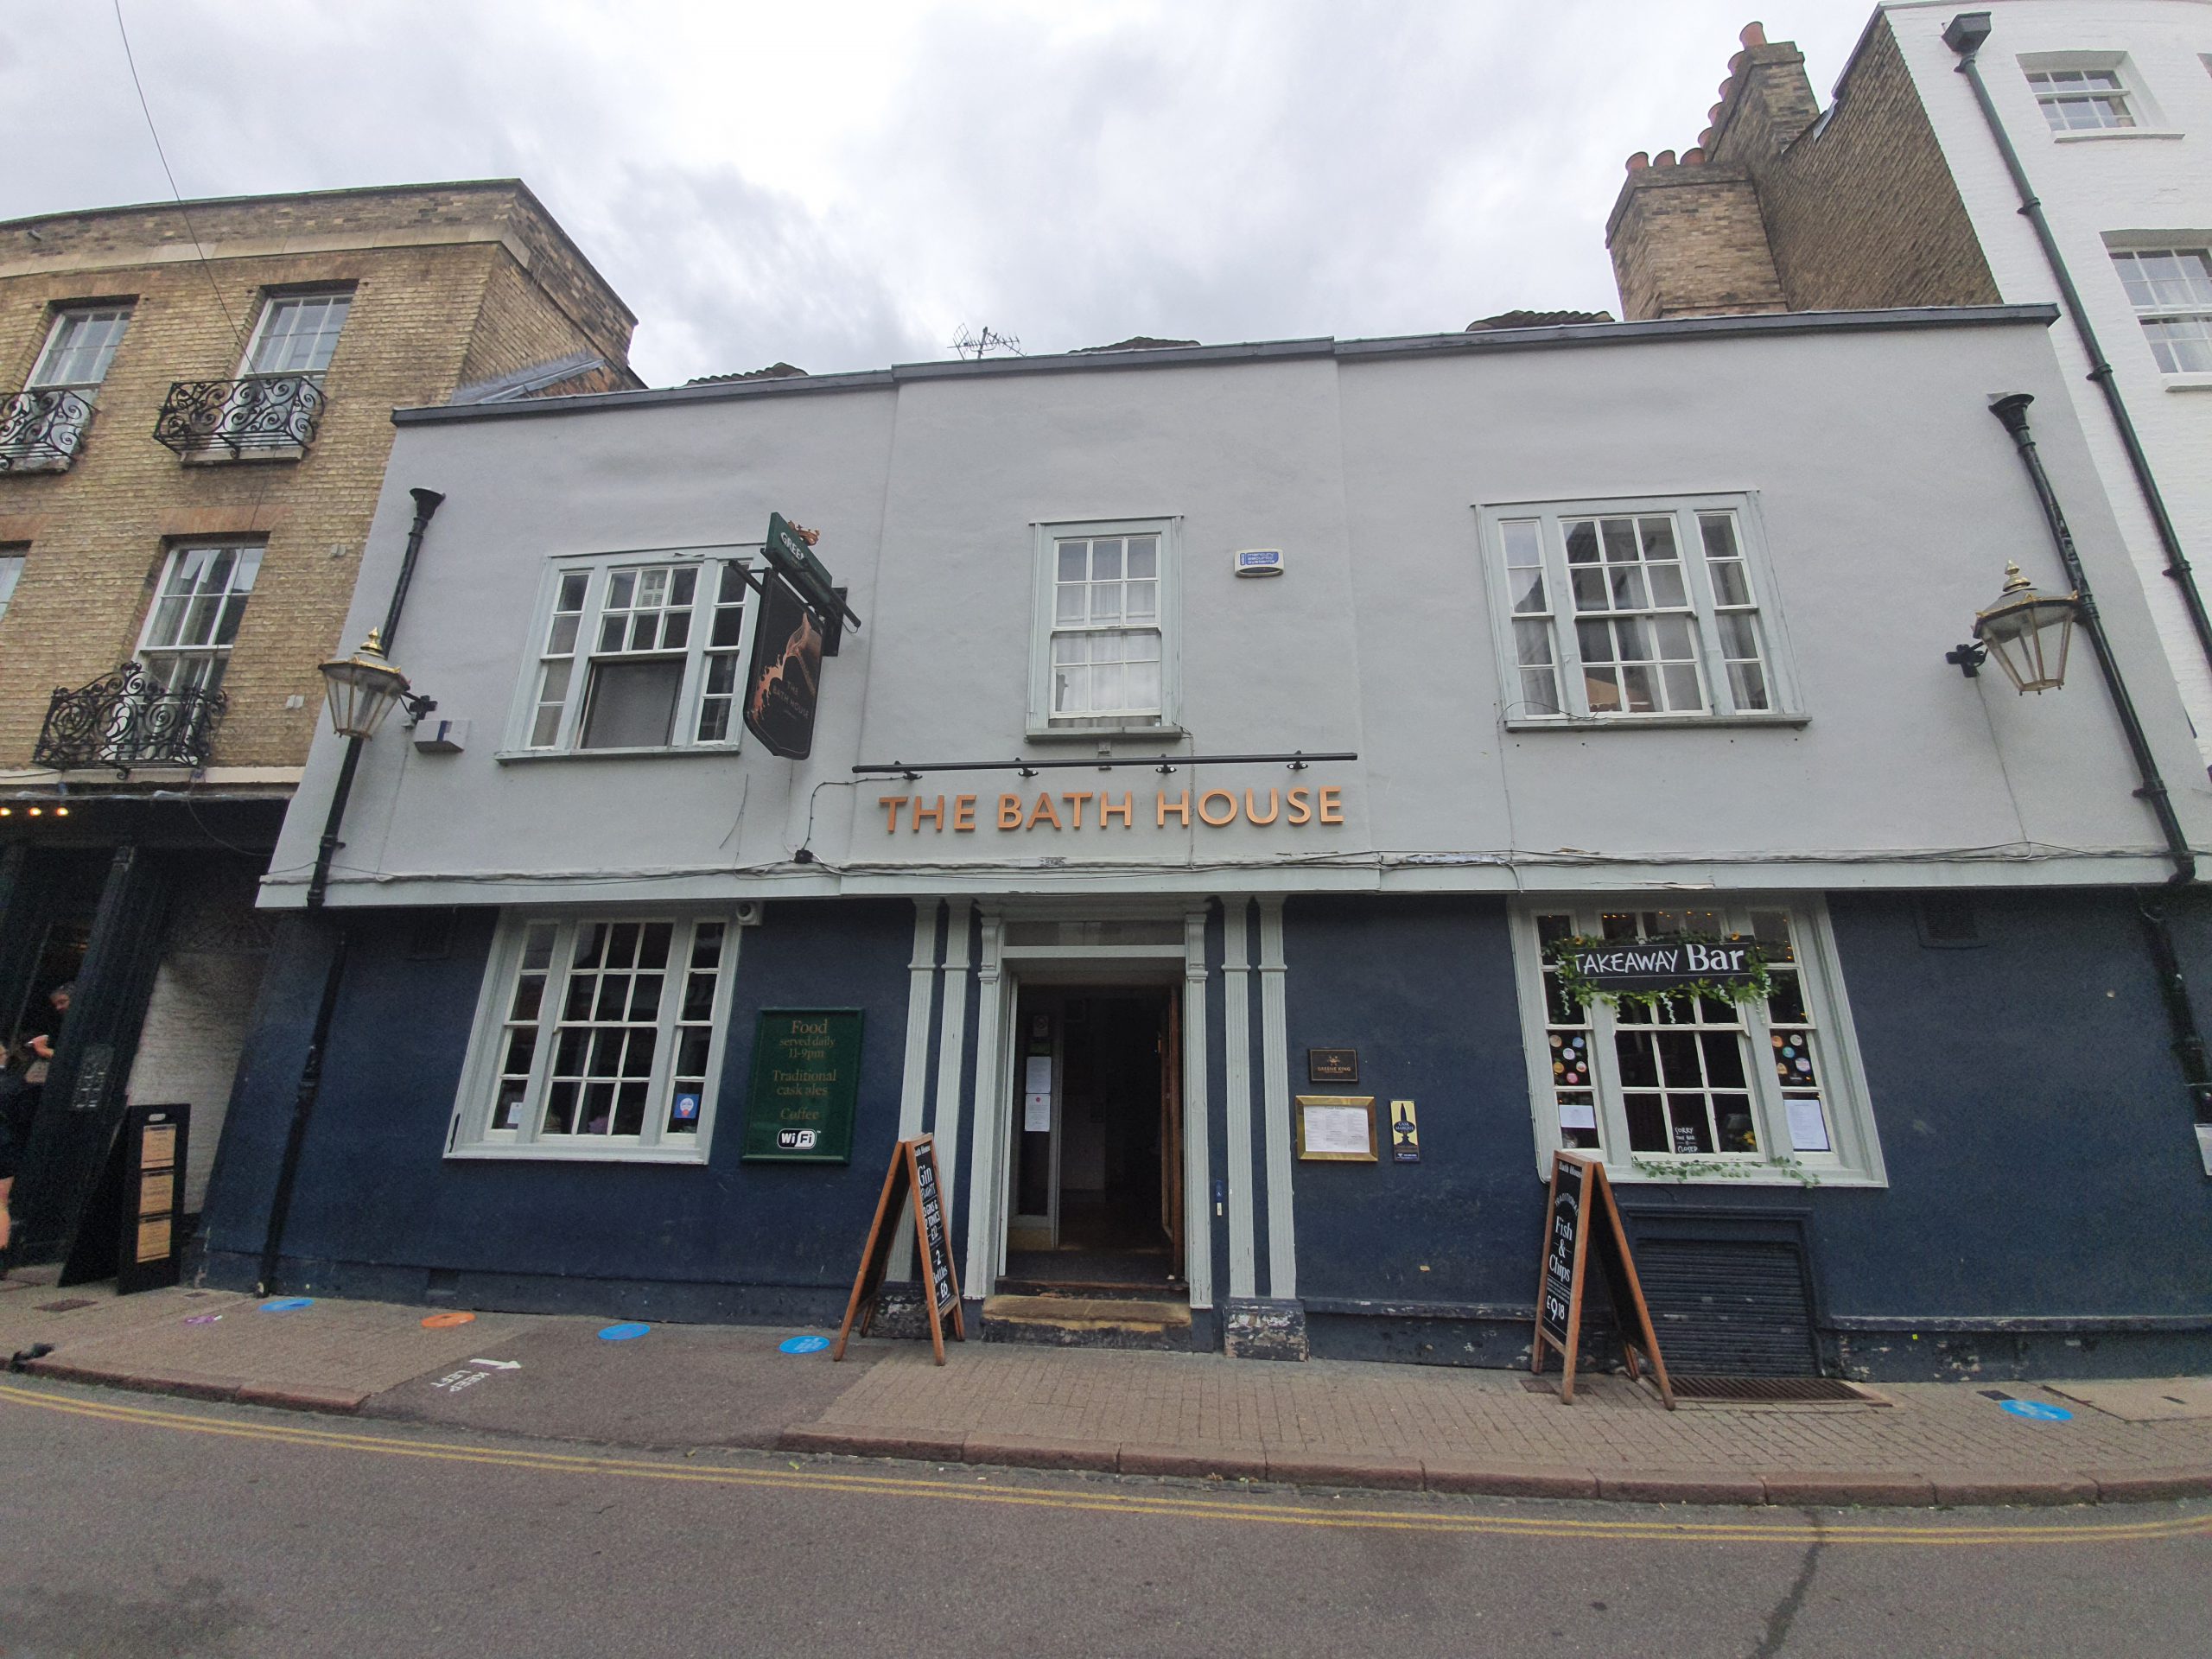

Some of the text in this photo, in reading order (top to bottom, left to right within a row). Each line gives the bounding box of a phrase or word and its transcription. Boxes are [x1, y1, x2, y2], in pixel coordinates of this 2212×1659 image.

[787, 680, 798, 696] THE
[790, 697, 810, 719] HOUSE
[879, 785, 1344, 833] THE BATH HOUSE
[1574, 944, 1745, 975] TAKEAWAY Bar
[791, 1018, 829, 1035] Food
[779, 1037, 836, 1048] served daily
[789, 1048, 825, 1060] 11-9pm
[773, 1069, 837, 1082] Traditional
[777, 1084, 829, 1096] cask ales
[779, 1107, 820, 1121] Coffee
[918, 1164, 933, 1187] Gin
[1555, 1193, 1580, 1216] TRADITIONAL
[1555, 1215, 1573, 1241] Fish
[936, 1249, 942, 1266] 2
[1558, 1238, 1566, 1258] &
[1549, 1254, 1571, 1282] Chips
[940, 1280, 949, 1299] £6
[449, 1371, 491, 1392] KEEP
